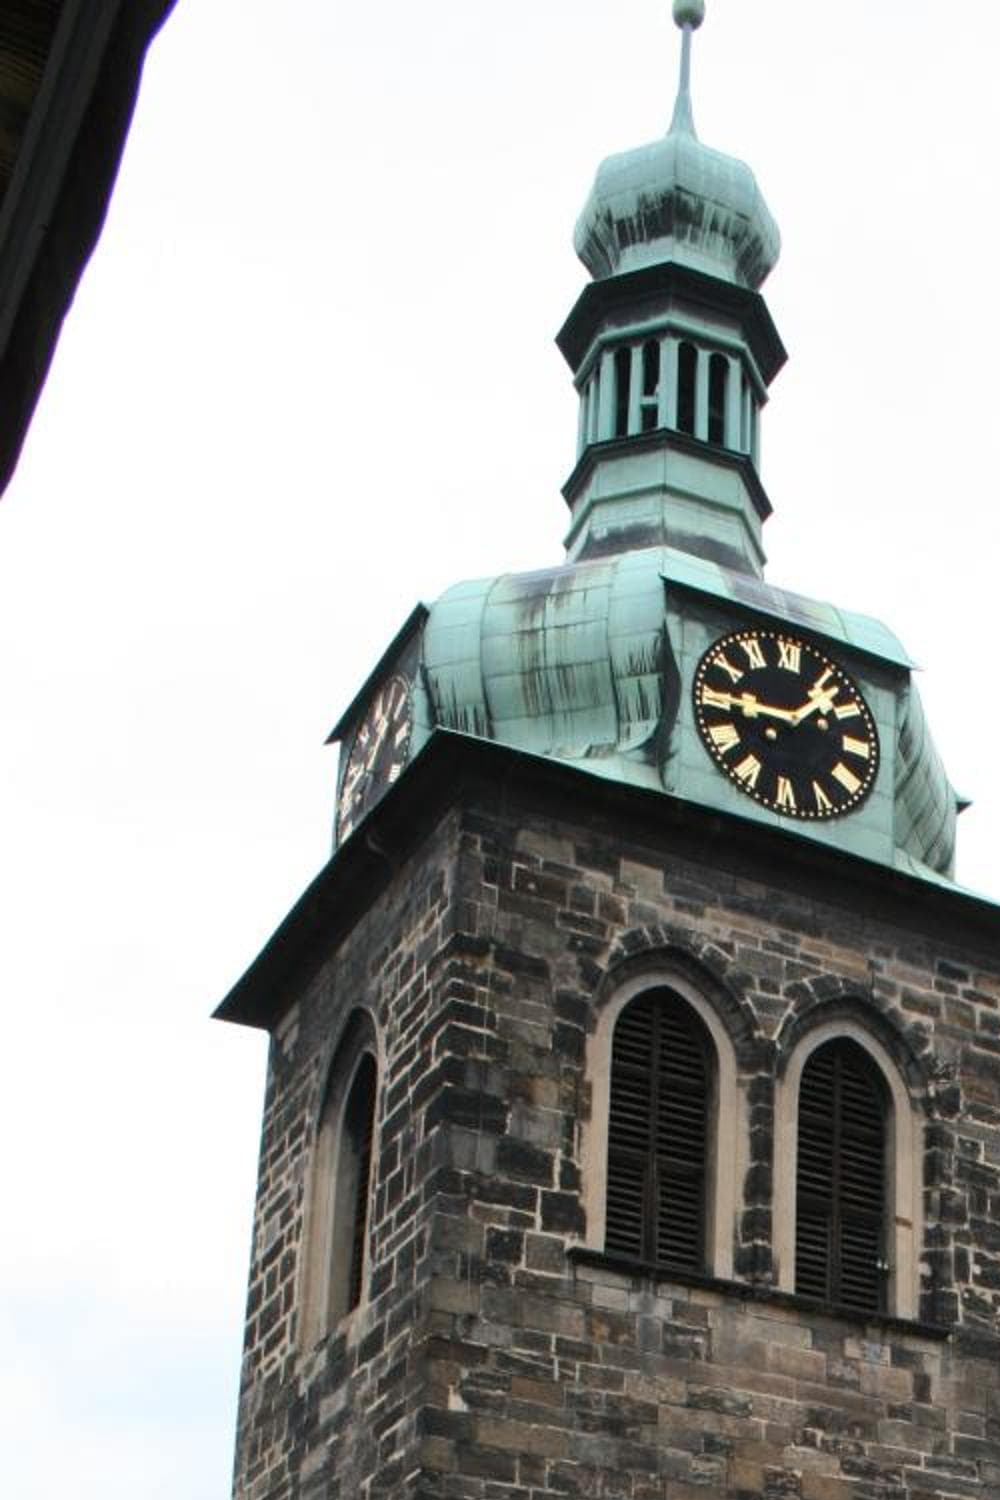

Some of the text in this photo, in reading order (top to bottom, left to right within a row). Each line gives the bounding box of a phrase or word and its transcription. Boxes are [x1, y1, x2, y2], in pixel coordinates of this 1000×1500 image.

[713, 653, 744, 683] X
[740, 639, 767, 669] XI
[777, 640, 801, 673] XII
[812, 781, 833, 811] V
